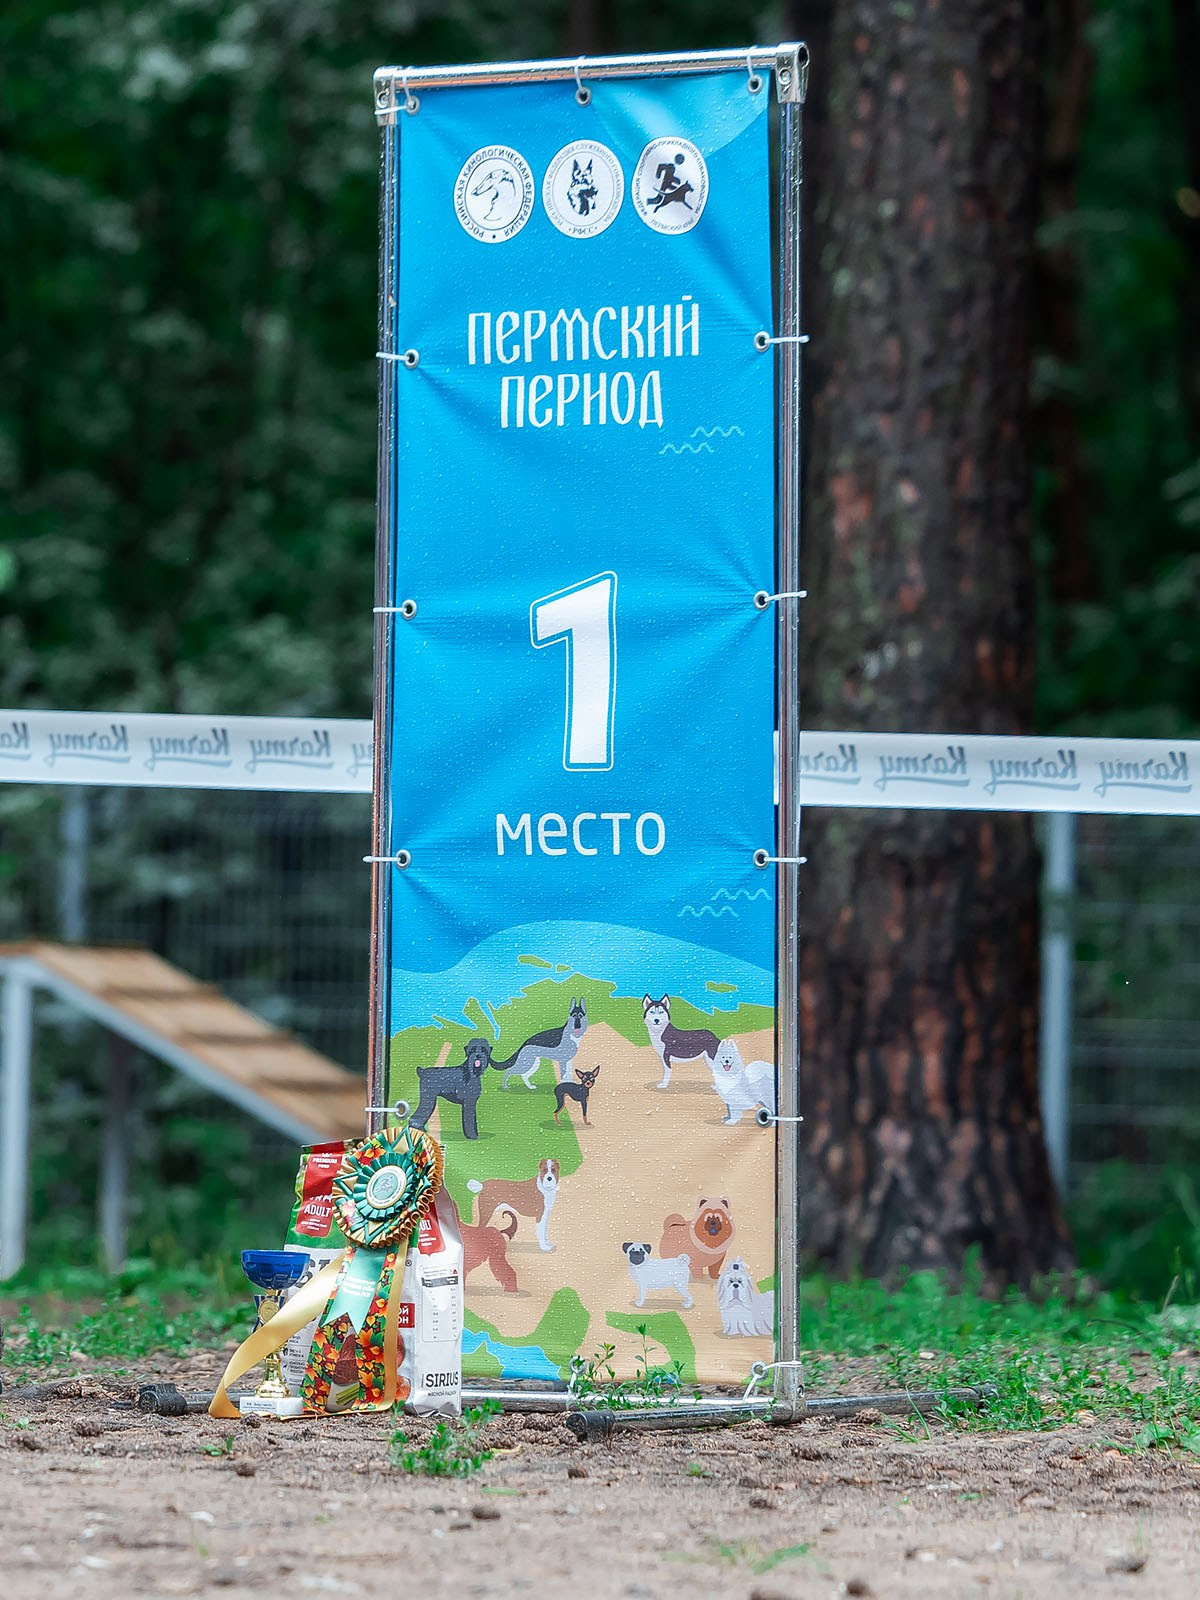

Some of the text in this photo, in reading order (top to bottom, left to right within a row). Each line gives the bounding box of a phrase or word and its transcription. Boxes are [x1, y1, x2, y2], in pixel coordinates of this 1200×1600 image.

[456, 147, 532, 238] РОССИЙСКАЯ КИНОЛОГИЧЕСКАЯ ФЕДЕРАЦИЯ
[468, 295, 699, 365] ПЕРМСКИЙ
[501, 370, 663, 429] ПЕРИОД
[530, 571, 617, 771] 1
[303, 1203, 332, 1218] ADULT
[425, 1371, 459, 1388] SIRIUS
